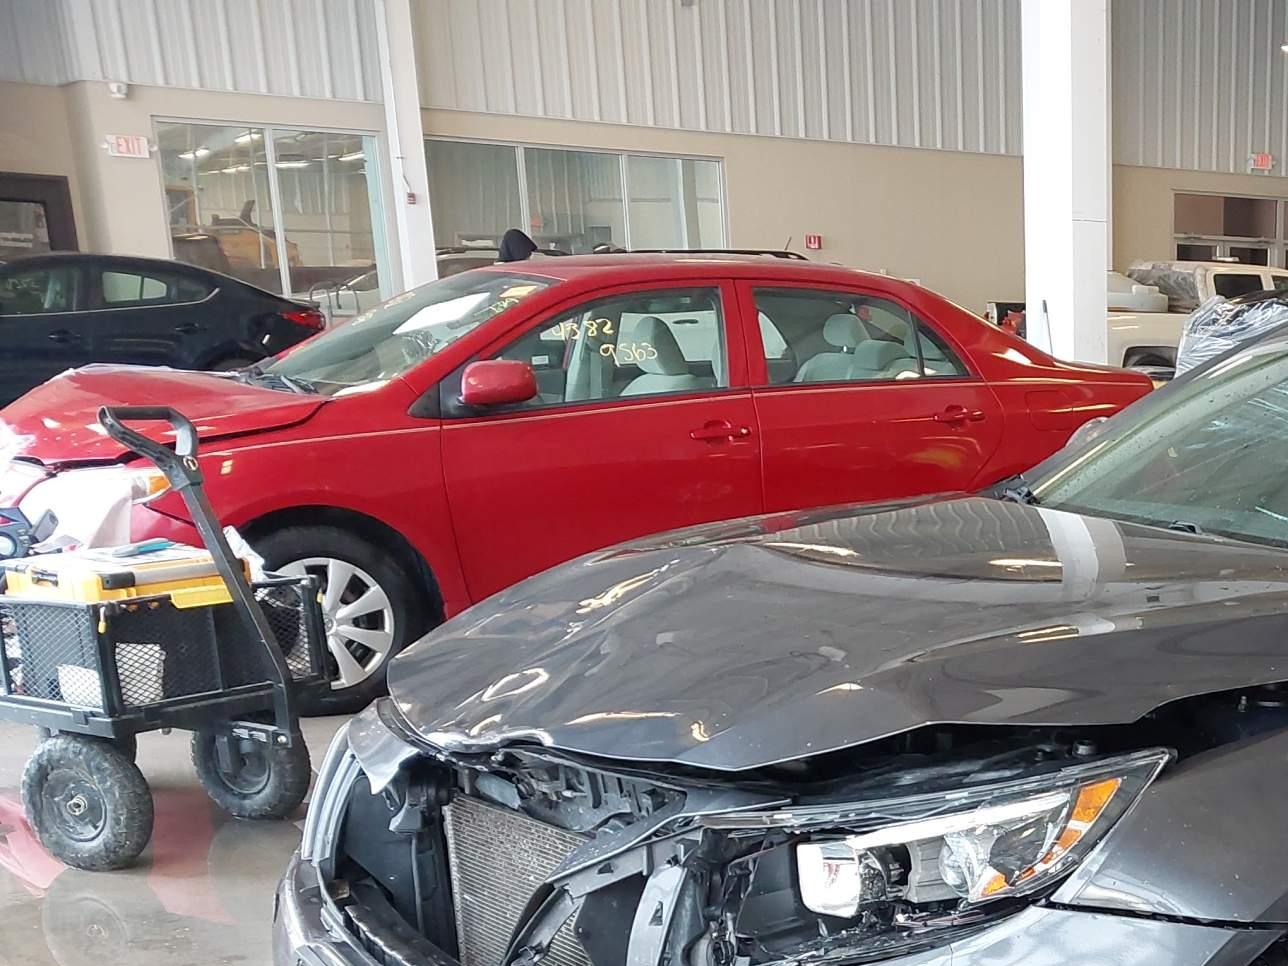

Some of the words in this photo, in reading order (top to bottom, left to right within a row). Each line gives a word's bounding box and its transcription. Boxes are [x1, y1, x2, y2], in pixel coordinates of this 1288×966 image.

[116, 136, 144, 155] EXIT
[551, 318, 615, 342] 4382
[599, 342, 658, 368] 9563
